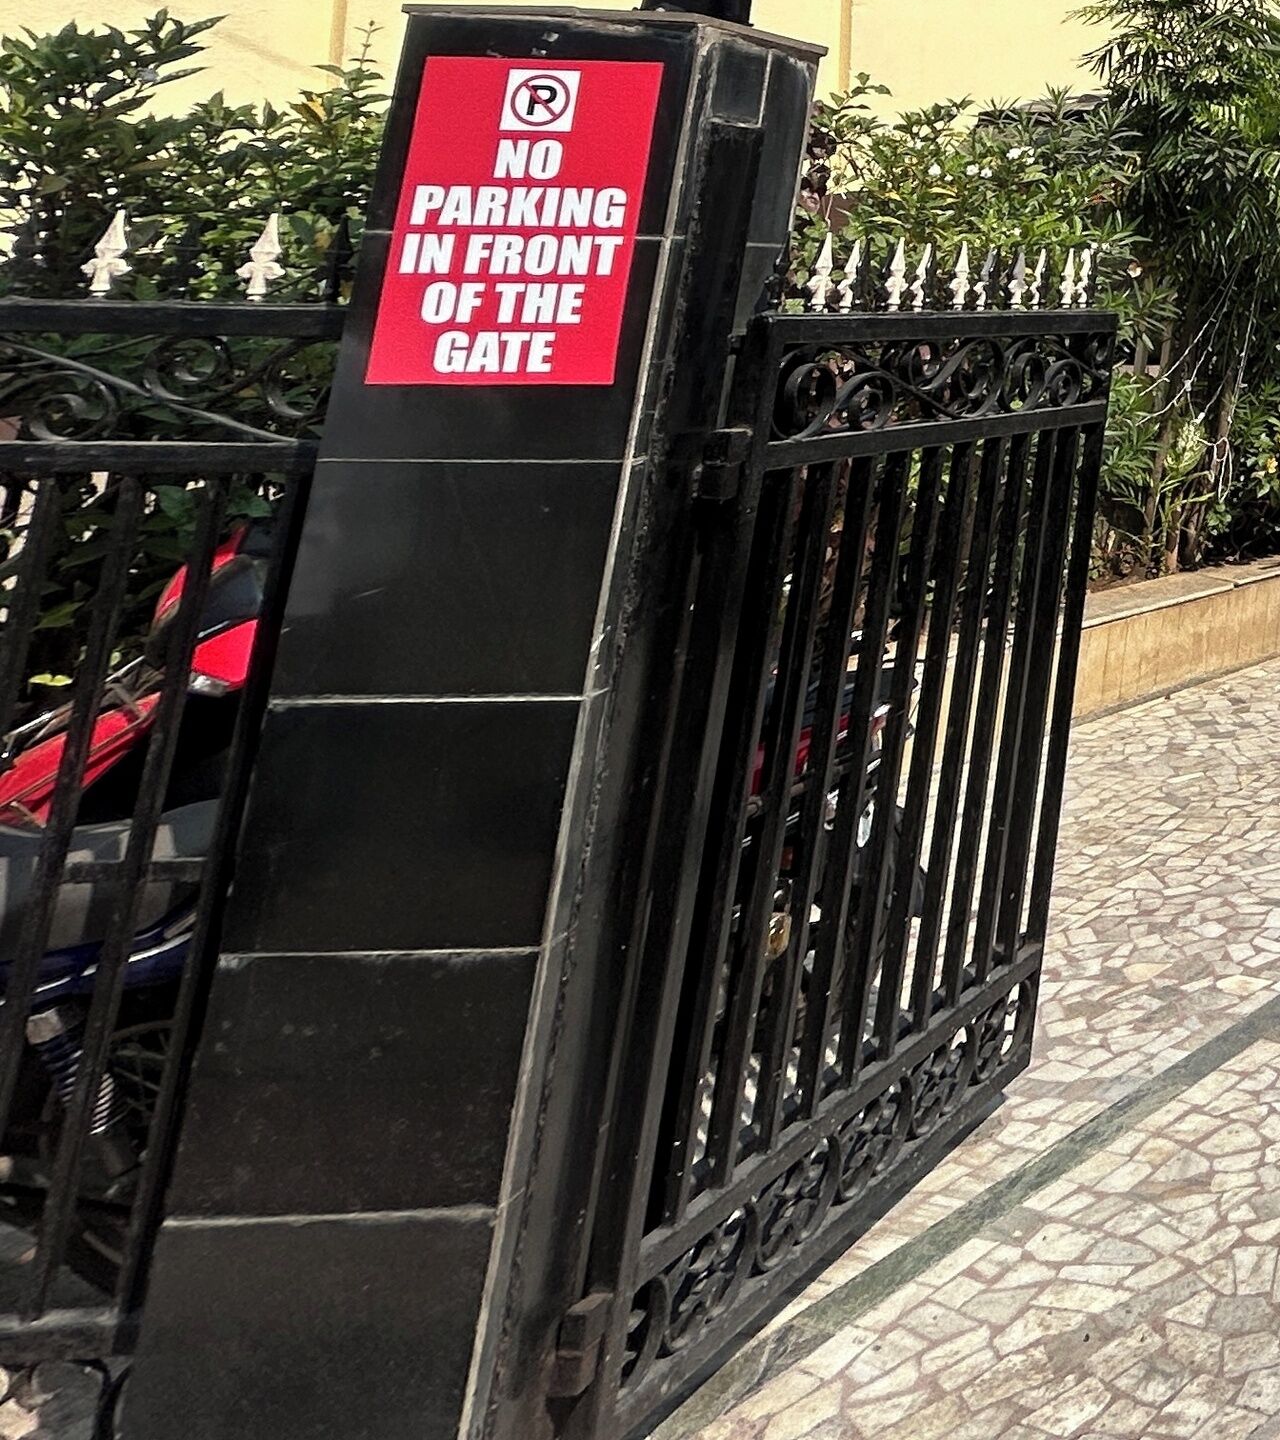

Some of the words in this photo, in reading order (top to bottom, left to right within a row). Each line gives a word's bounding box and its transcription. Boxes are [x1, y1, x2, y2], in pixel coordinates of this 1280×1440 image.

[493, 139, 563, 180] NO
[409, 185, 628, 229] PARKING
[398, 233, 456, 275] IN
[463, 234, 624, 276] FRONT
[420, 281, 486, 324] OF
[495, 282, 586, 324] THE
[433, 330, 556, 374] GATE
